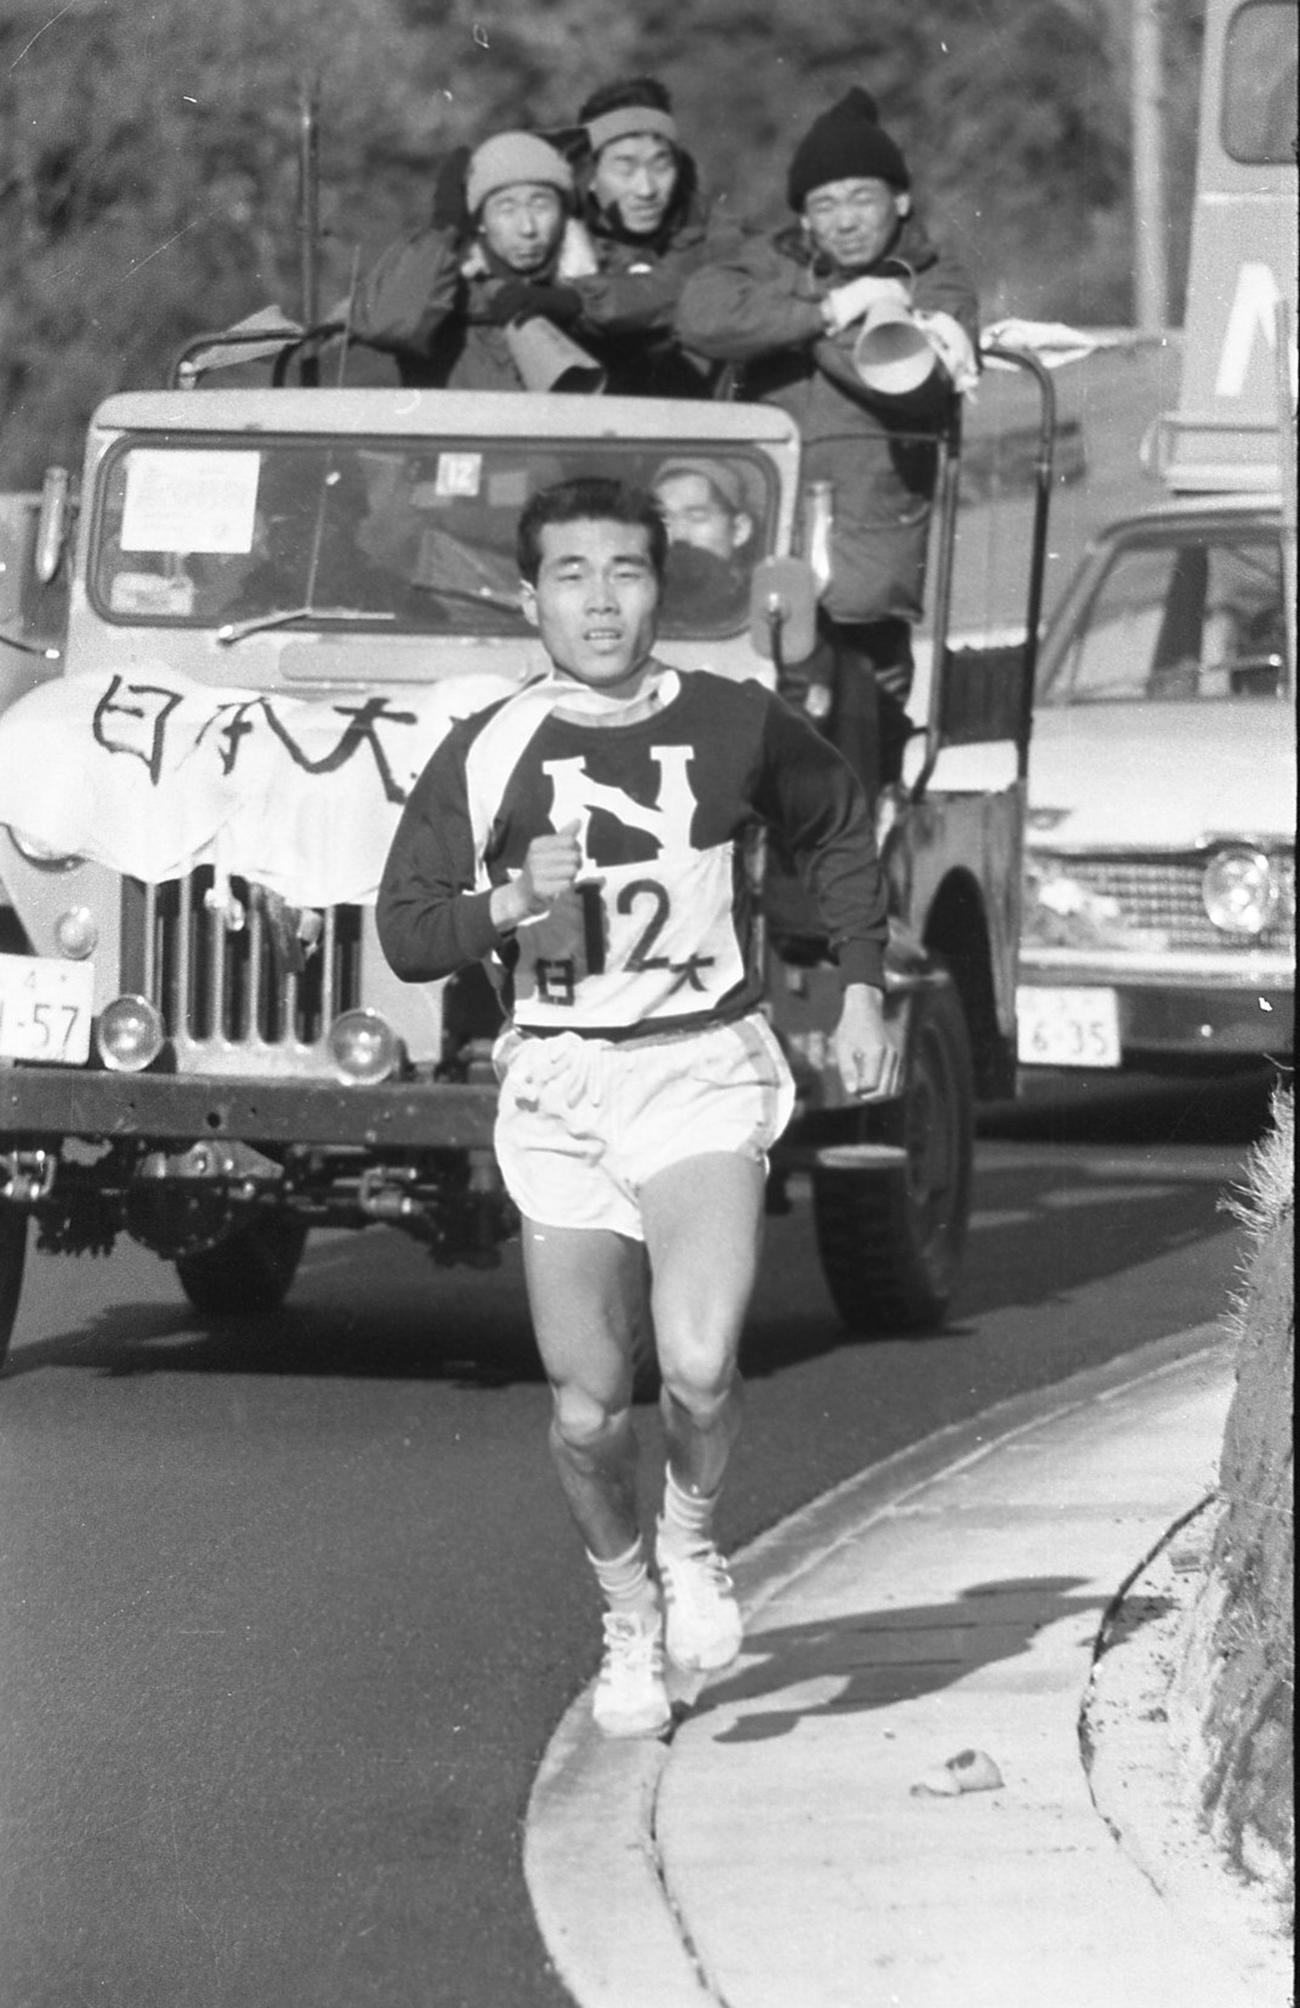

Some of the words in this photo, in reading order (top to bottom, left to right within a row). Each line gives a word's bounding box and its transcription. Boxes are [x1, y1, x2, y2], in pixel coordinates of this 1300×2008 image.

[448, 461, 473, 488] 12
[542, 745, 697, 868] N
[575, 878, 670, 976] 12
